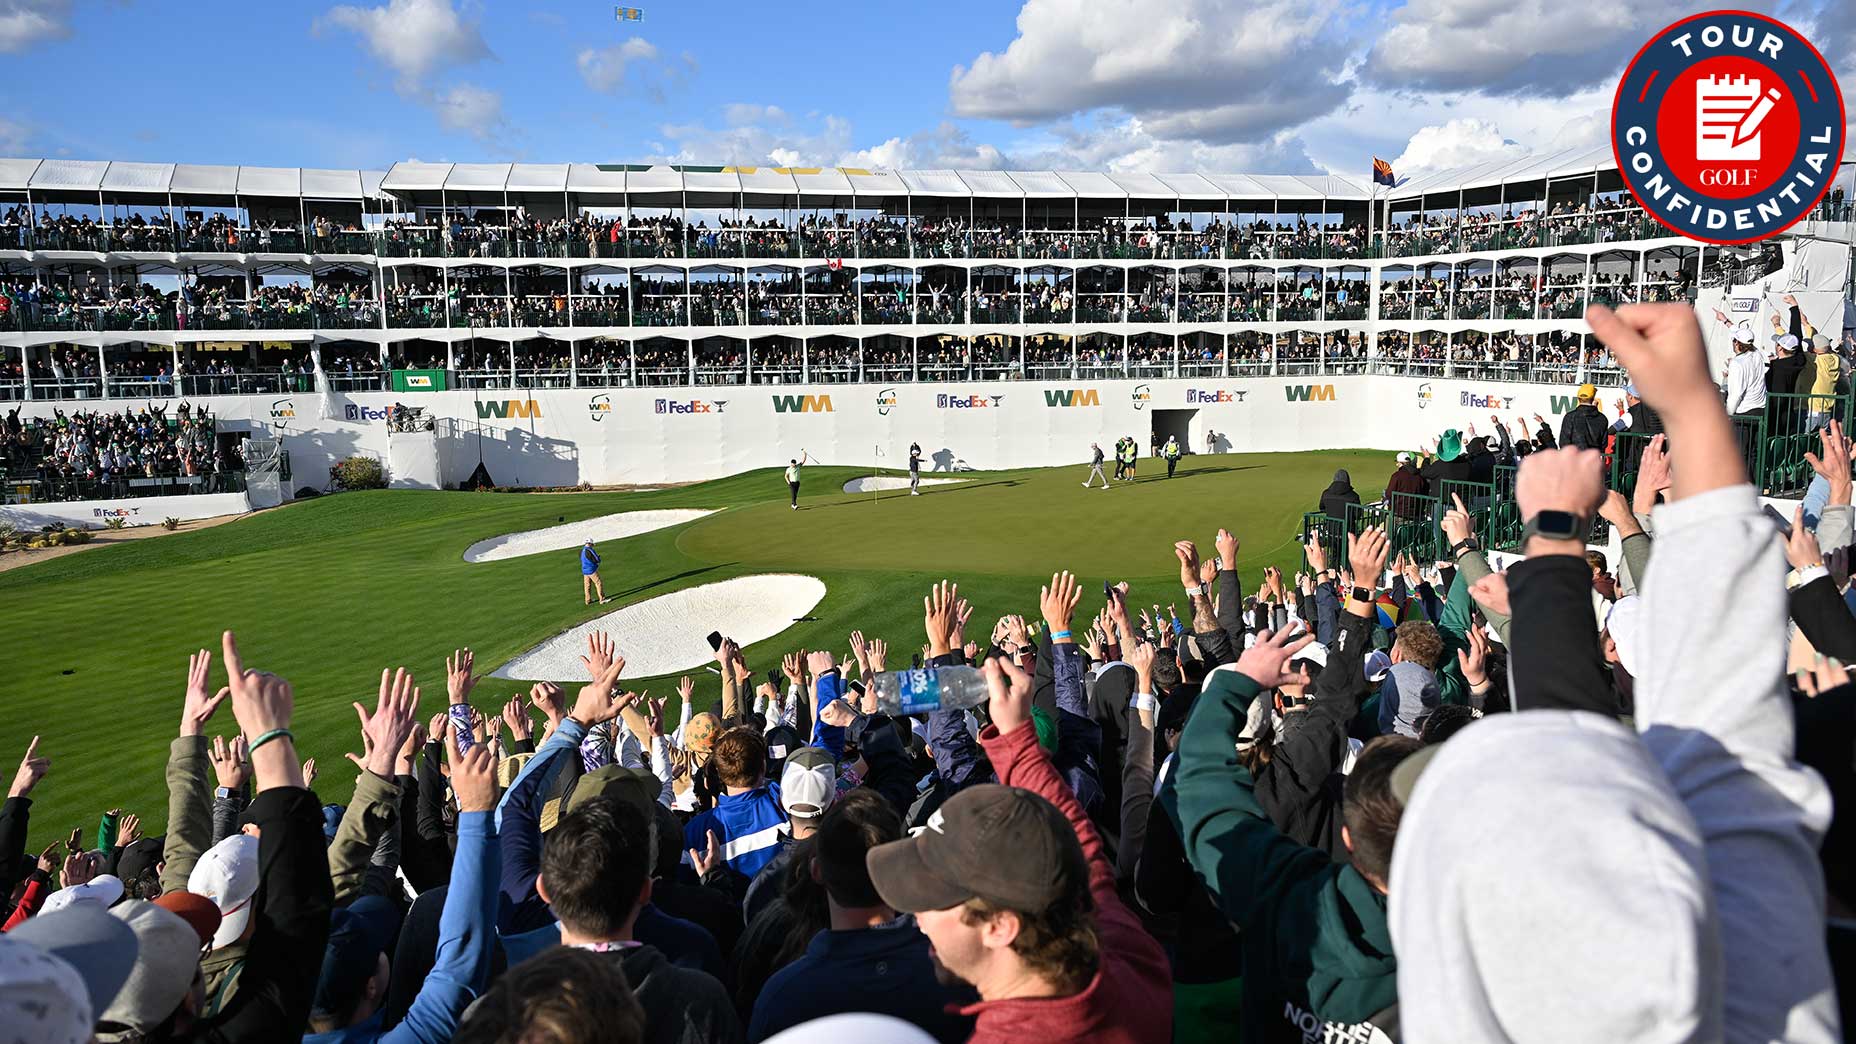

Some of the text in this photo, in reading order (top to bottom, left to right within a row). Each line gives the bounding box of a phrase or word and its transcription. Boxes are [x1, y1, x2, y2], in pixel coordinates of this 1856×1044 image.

[1044, 389, 1100, 407] WM
[1198, 390, 1233, 403] FedEx
[1285, 384, 1336, 402] WM
[589, 403, 611, 411] WM
[669, 400, 711, 414] FedEx
[772, 395, 833, 413] WM
[949, 395, 988, 409] FedEx
[1470, 394, 1501, 409] FedEx
[270, 410, 295, 418] WM
[474, 400, 542, 418] WM
[103, 509, 129, 517] FedEx
